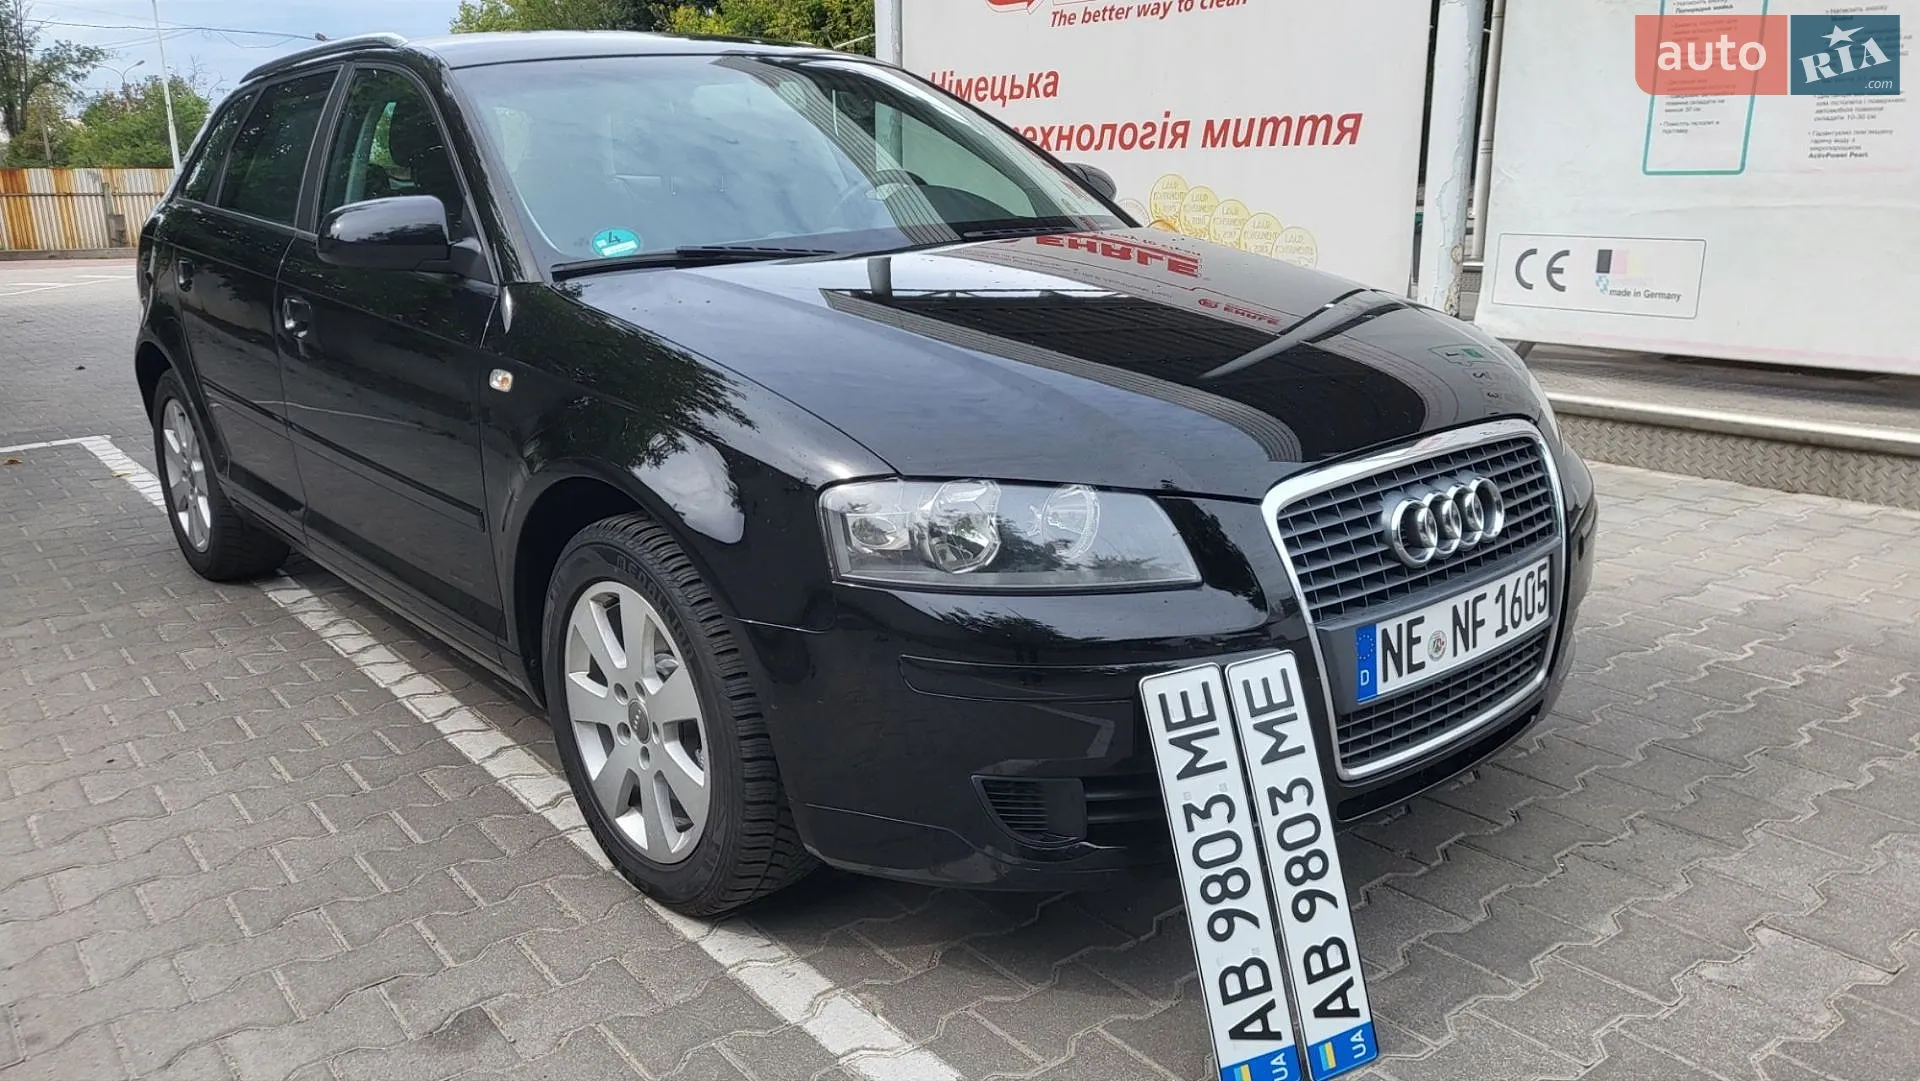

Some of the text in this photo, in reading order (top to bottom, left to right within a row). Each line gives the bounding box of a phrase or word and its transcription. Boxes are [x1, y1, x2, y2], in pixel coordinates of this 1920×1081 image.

[1050, 10, 1077, 28] The
[1081, 3, 1133, 25] better
[1136, 2, 1172, 20] way
[1177, 0, 1194, 13] to
[1013, 111, 1364, 151] ехнологія миття
[1609, 288, 1681, 302] made in Germany
[1381, 615, 1426, 684] NE
[1452, 592, 1487, 658] NF
[1495, 563, 1548, 638] 1605
[1360, 669, 1370, 687] D
[1242, 667, 1361, 1019] AB 9803 ME
[1158, 680, 1283, 1041] AB 9803 ME
[1352, 1029, 1367, 1060] UA
[1273, 1052, 1287, 1081] UA
